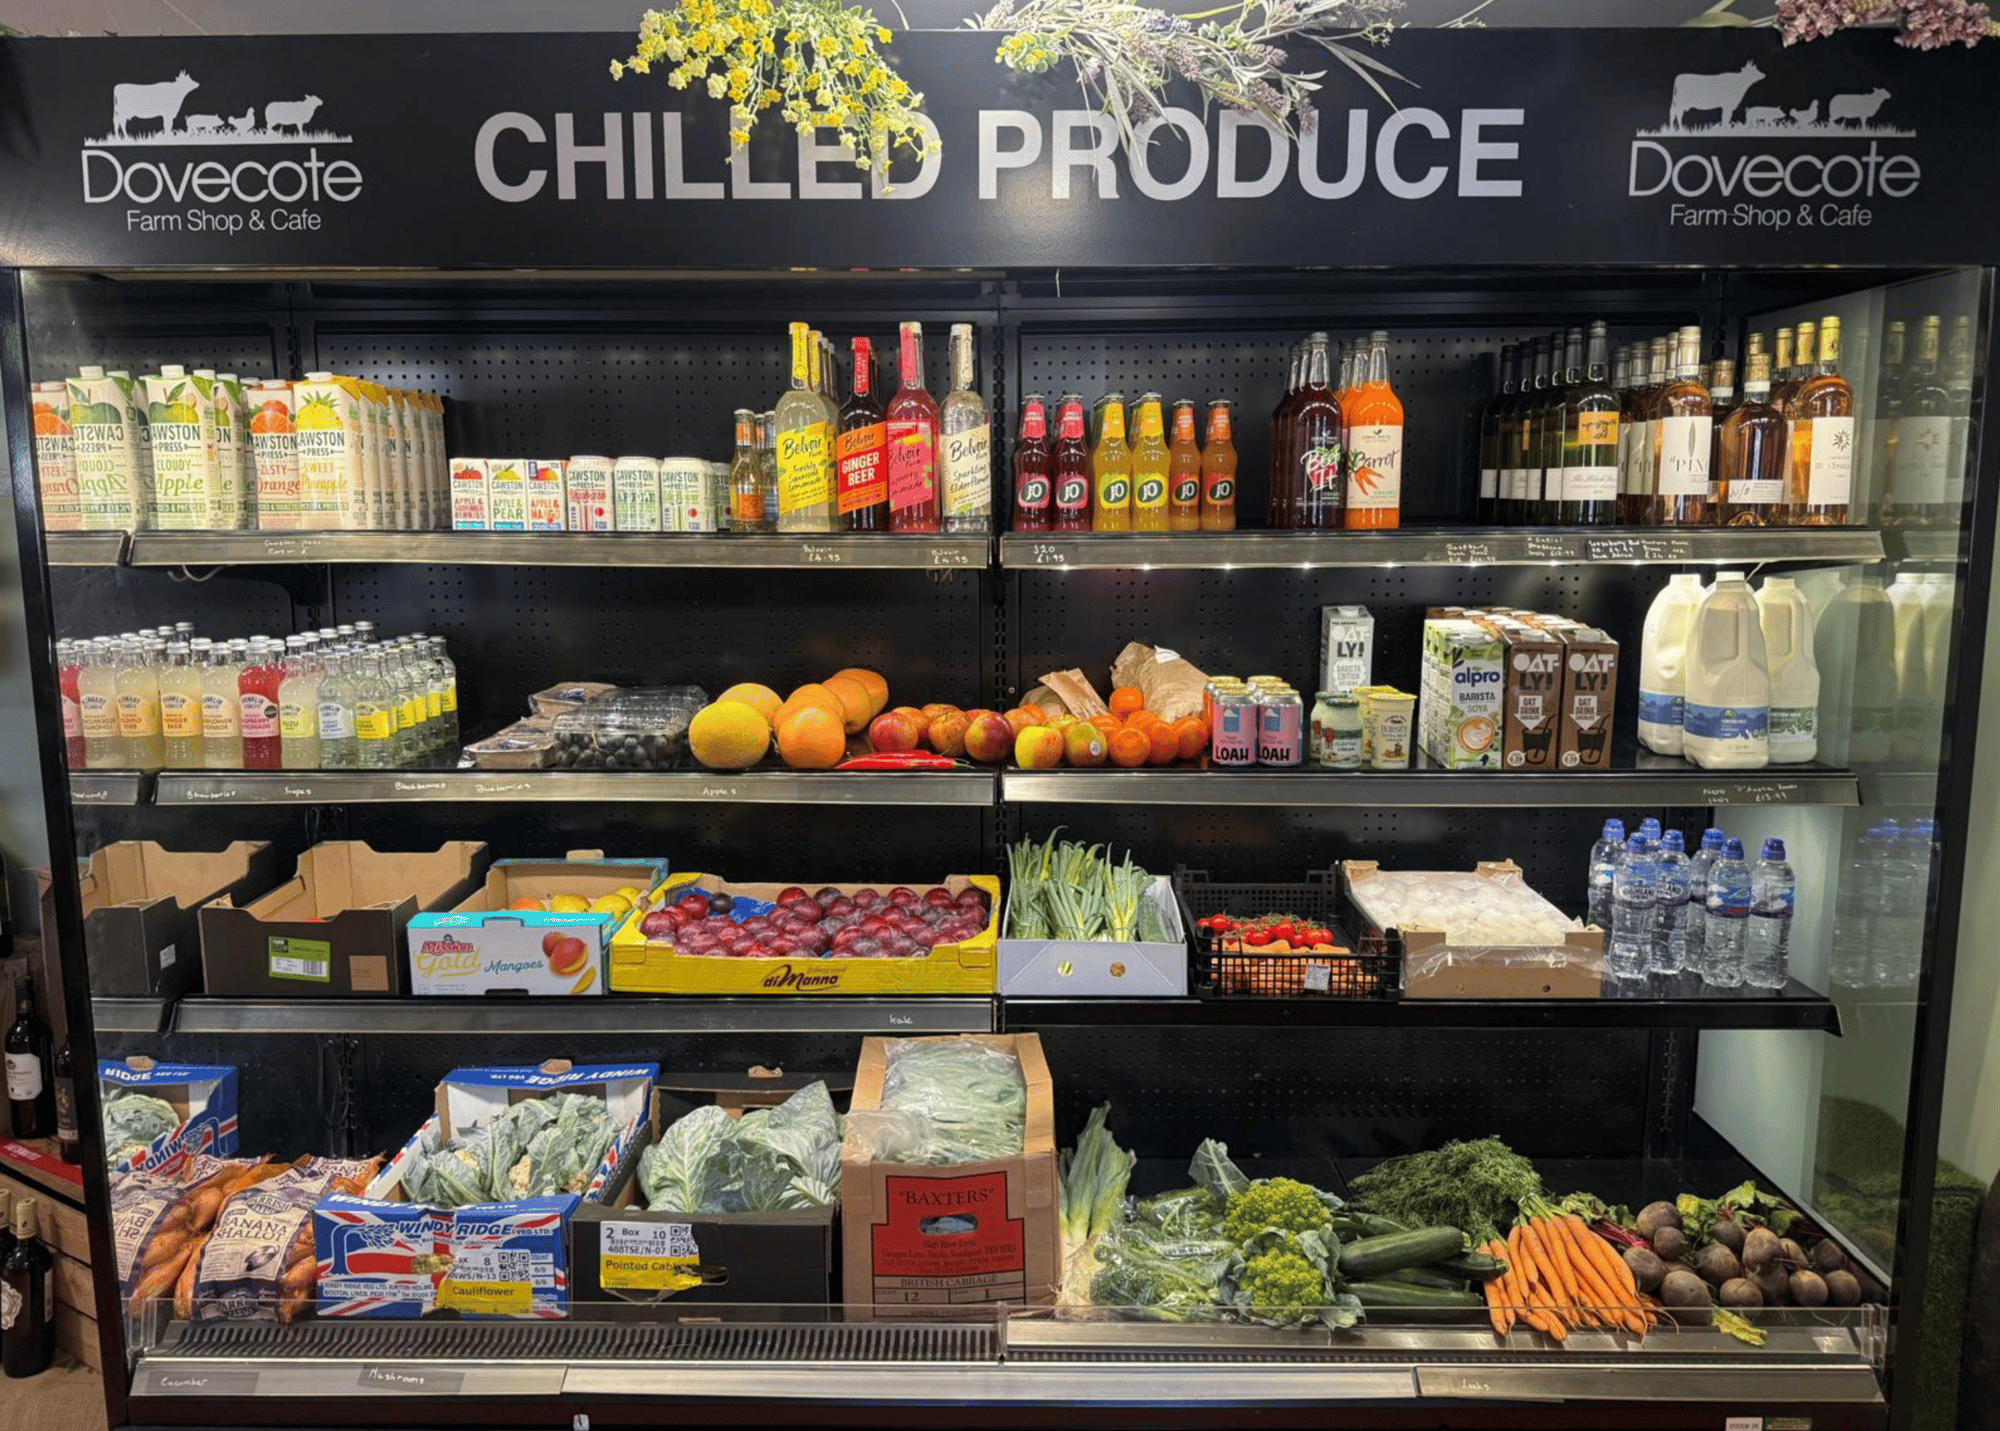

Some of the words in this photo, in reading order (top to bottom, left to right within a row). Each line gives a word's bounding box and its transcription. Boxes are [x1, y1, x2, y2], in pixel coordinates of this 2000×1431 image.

[474, 109, 943, 203] CHILLED
[978, 107, 1525, 201] PRODUCE
[82, 147, 363, 204] Dovecote
[1628, 140, 1921, 198] Dovecote
[127, 209, 181, 231] Farm
[187, 209, 242, 235] Shop
[248, 212, 265, 231] &
[271, 209, 321, 231] Cafe
[1670, 204, 1727, 227] Farm
[1732, 203, 1790, 230] Shop
[1796, 205, 1814, 226] &
[1819, 203, 1872, 227] Cafe
[152, 425, 200, 441] AWSTON
[298, 431, 345, 446] AWSTON
[255, 436, 297, 450] AWSTON
[842, 452, 879, 473] GINGER
[848, 467, 875, 486] BEER
[493, 508, 523, 519] PEAR
[1337, 642, 1365, 658] LY!
[1454, 667, 1501, 687] alpro
[1519, 673, 1554, 691] LY!
[1575, 673, 1608, 691] LY!
[1459, 691, 1496, 701] BARISTA
[1523, 698, 1537, 707] OAT
[1579, 698, 1592, 707] OAT
[1466, 704, 1488, 713] SOYA
[1521, 706, 1541, 714] DRINK
[1576, 706, 1595, 714] DRINK
[1215, 746, 1249, 760] LOAH
[1258, 746, 1290, 761] LOAH
[484, 960, 544, 976] Mangoes
[222, 1217, 287, 1234] BANANA
[400, 1219, 455, 1234] WINDY
[457, 1223, 515, 1236] RIDGE
[605, 1227, 614, 1239] 2
[622, 1228, 640, 1236] Box
[652, 1231, 667, 1239] 10
[484, 1257, 492, 1266] 8
[605, 1260, 648, 1271] Pointed
[901, 1278, 944, 1288] BRITISH
[946, 1275, 997, 1287] CABBAGE
[452, 1285, 516, 1297] Cauliflower
[904, 1291, 920, 1302] 12
[160, 1376, 208, 1387] Cucumber
